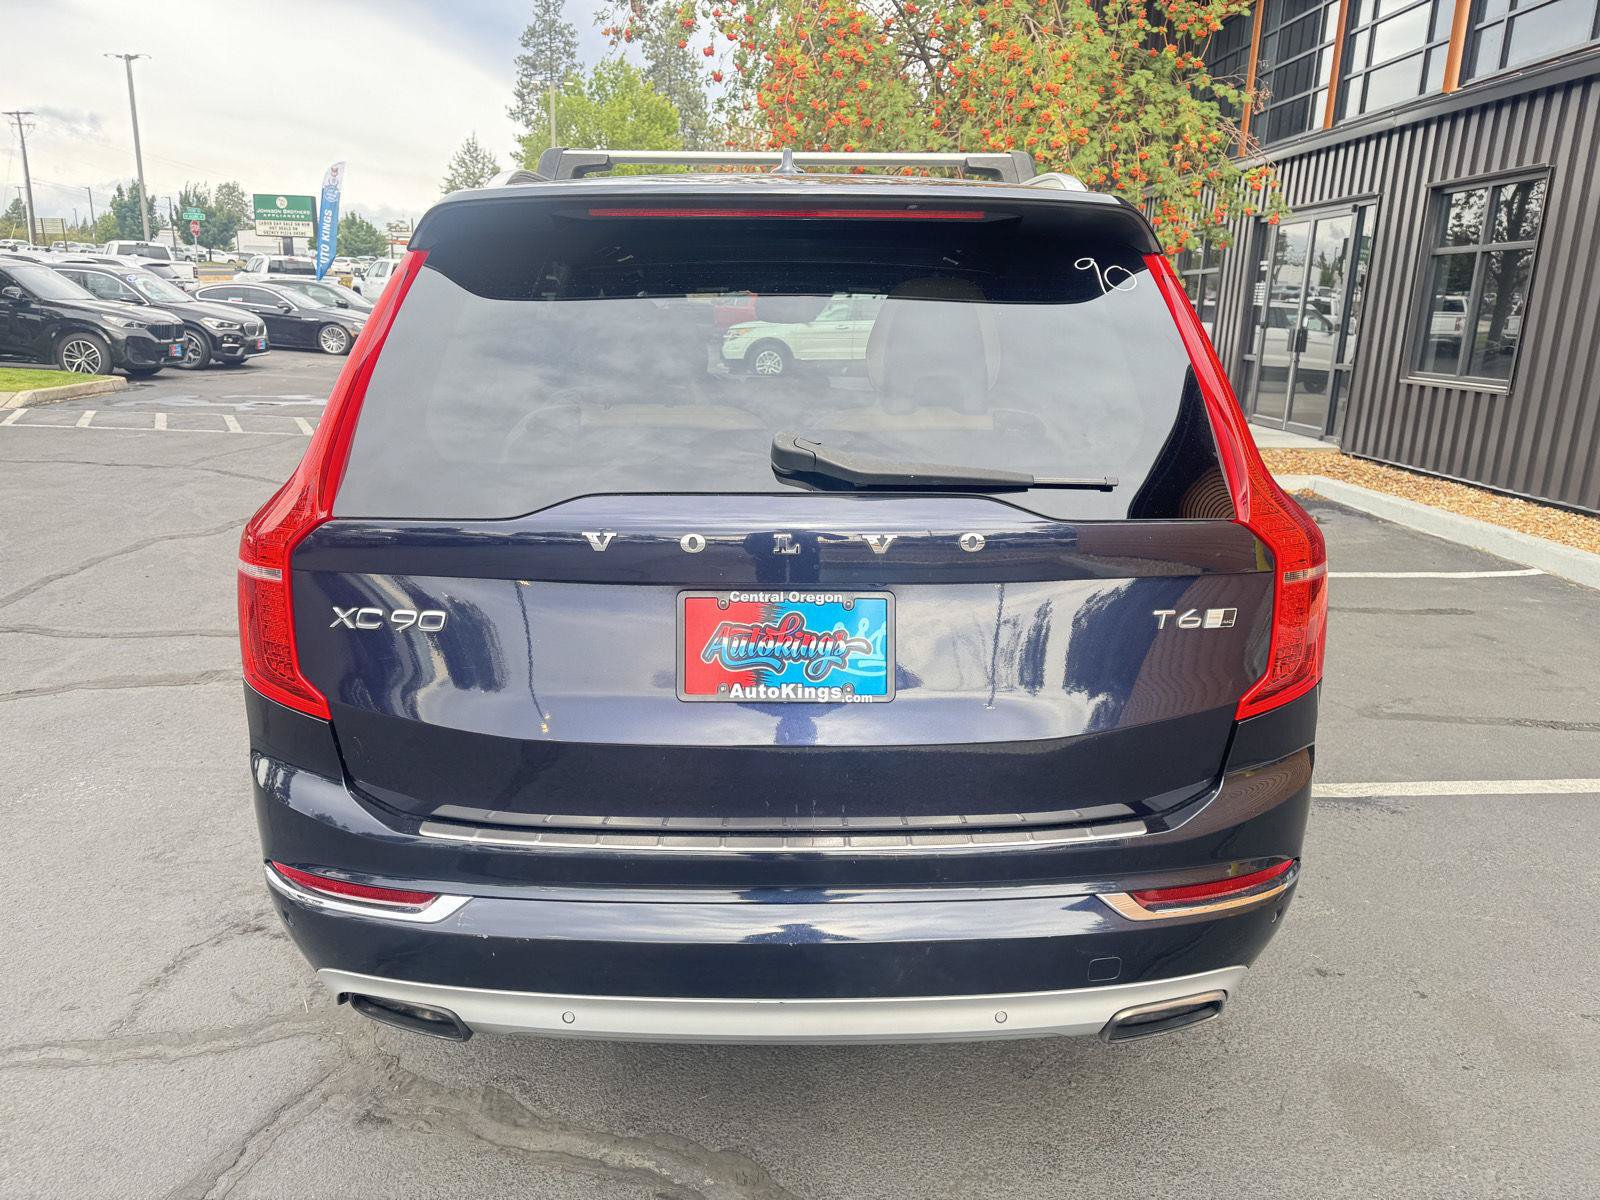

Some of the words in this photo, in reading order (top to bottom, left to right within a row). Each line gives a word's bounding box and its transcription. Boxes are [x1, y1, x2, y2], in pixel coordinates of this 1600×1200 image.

[322, 208, 332, 242] KINGS
[581, 530, 988, 555] VOLVO
[729, 591, 784, 603] Central
[788, 591, 843, 605] Oregon
[1153, 608, 1202, 630] T6
